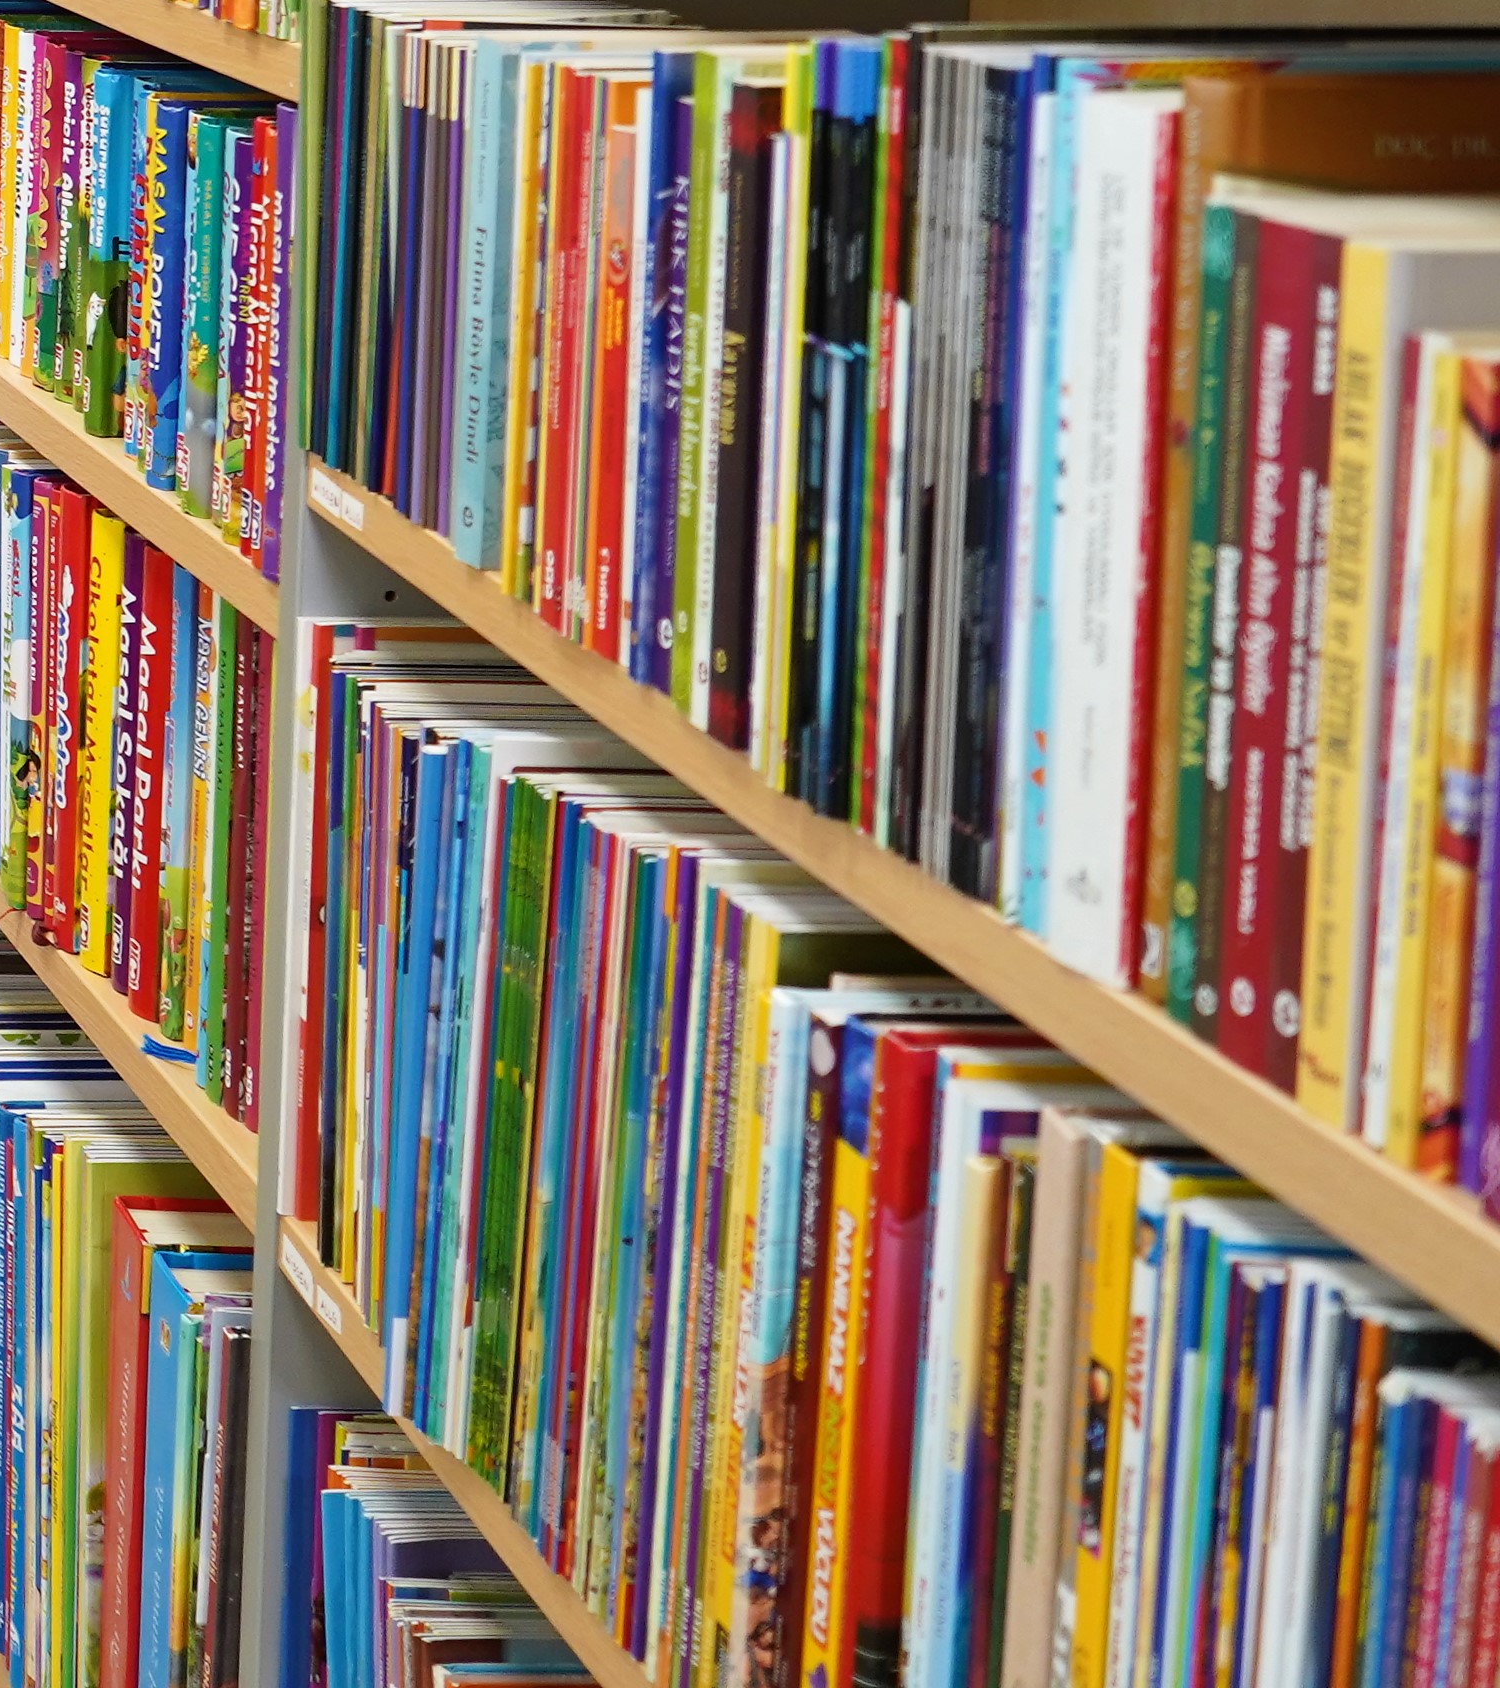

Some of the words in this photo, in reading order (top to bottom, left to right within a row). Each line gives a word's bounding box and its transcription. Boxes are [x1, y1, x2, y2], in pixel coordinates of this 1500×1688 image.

[60, 81, 76, 163] Biricik
[82, 83, 94, 168] Yücelerden
[58, 172, 73, 270] Allah'ım
[82, 174, 93, 208] Yüce
[152, 127, 168, 234] MASAL
[672, 177, 690, 256] KIRK
[148, 253, 164, 371] ROKETİ
[239, 273, 252, 323] TRENİ
[471, 226, 488, 306] Fırtına
[467, 315, 485, 385] Böyle
[665, 284, 685, 412] HADİS
[465, 394, 483, 465] Dindi
[117, 583, 137, 719] Masal
[134, 612, 159, 758] Masal
[113, 734, 135, 879] Sokağı
[132, 765, 151, 890] Parkı
[825, 1207, 859, 1396] İNANILMAZ
[819, 1399, 843, 1502] İNSAN
[810, 1508, 837, 1644] VÜCUDU
